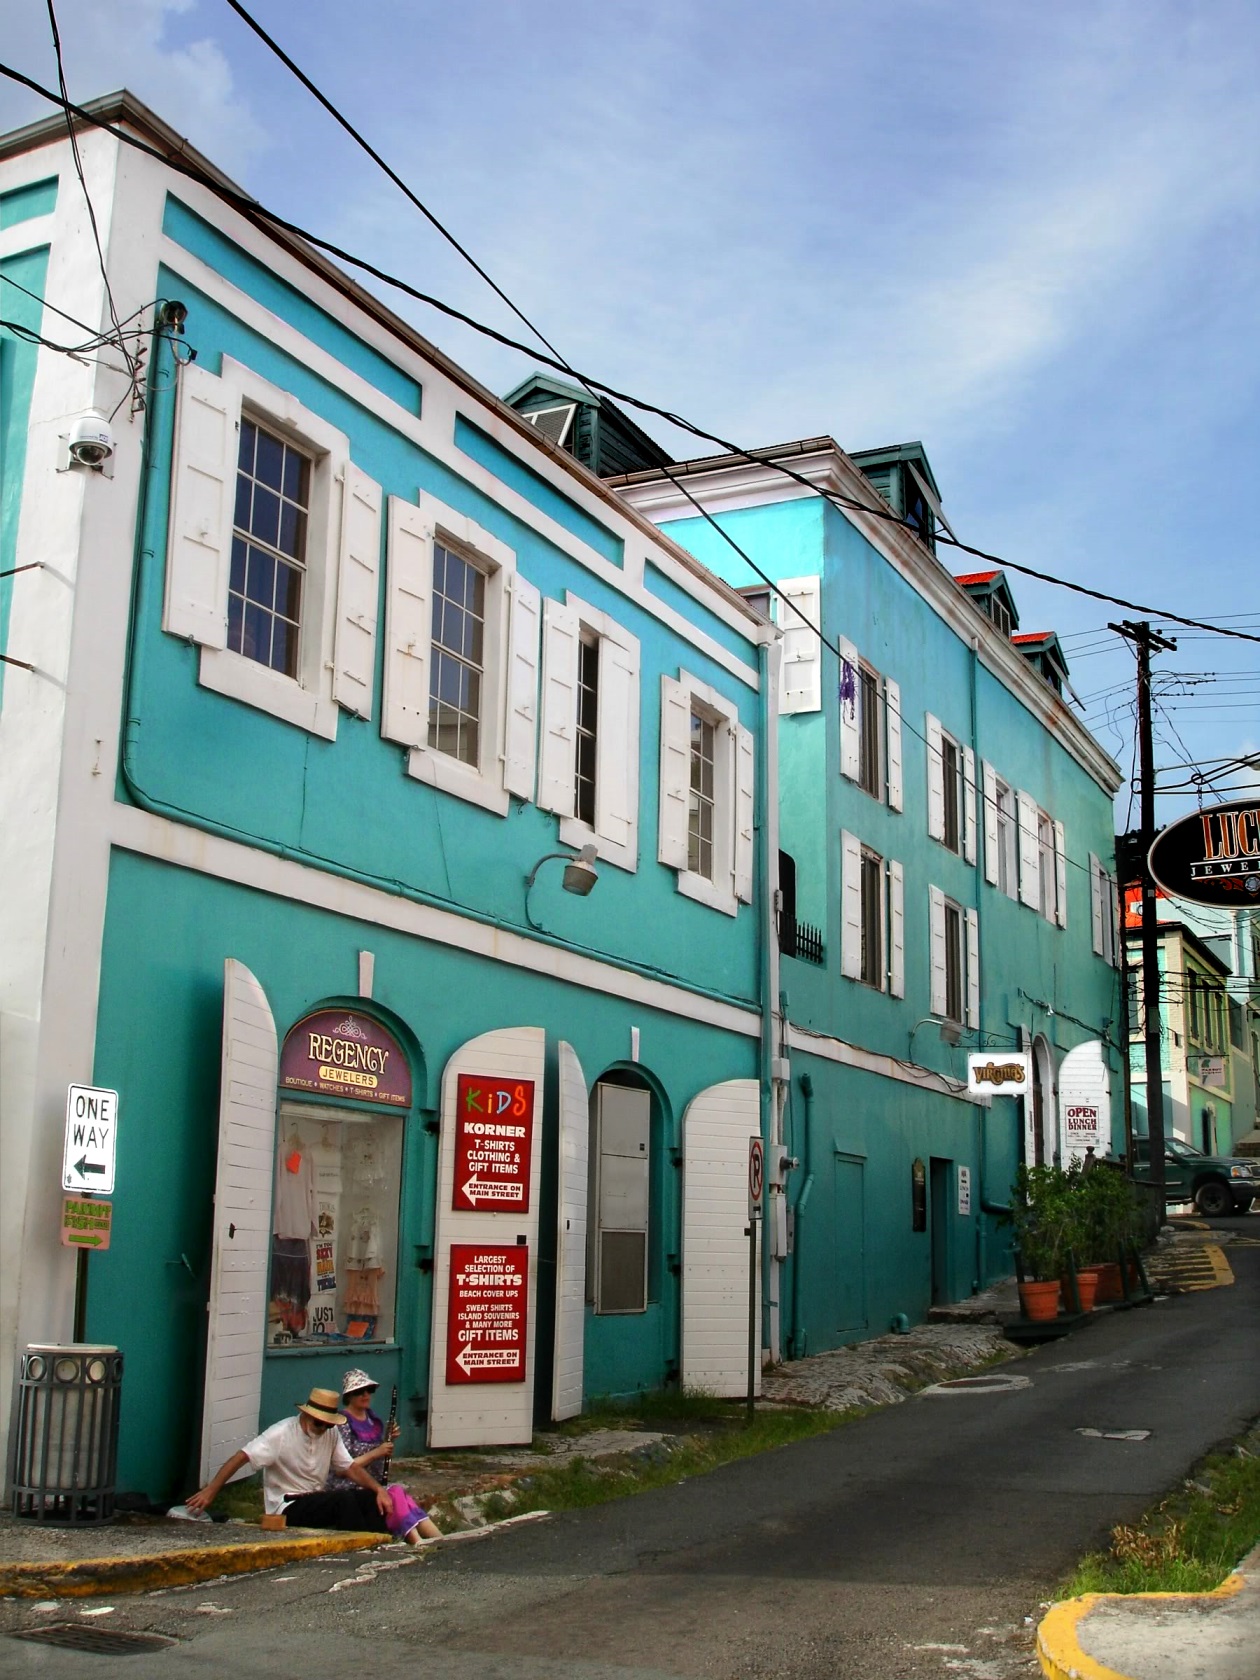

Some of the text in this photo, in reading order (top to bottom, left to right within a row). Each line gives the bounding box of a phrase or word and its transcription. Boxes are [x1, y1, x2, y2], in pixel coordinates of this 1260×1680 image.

[308, 1033, 389, 1074] REGENCY
[322, 1068, 374, 1086] JEWELERS
[285, 1076, 313, 1087] BOUTIQUE
[319, 1082, 344, 1093] WATCHES
[379, 1092, 390, 1101] GIFT
[391, 1094, 405, 1103] ITEMS
[75, 1095, 110, 1122] ONE
[1067, 1107, 1097, 1118] OPEN
[73, 1123, 110, 1149] WAY
[463, 1122, 526, 1138] KORNER
[474, 1139, 515, 1152] T-SHIRTS
[467, 1150, 521, 1163] CLOTHING &
[468, 1162, 518, 1174] GIFT ITEMS
[468, 1183, 521, 1192] ENTRANCE ON
[491, 1190, 520, 1198] STREET
[474, 1255, 507, 1264] LARGEST
[464, 1264, 515, 1273] SELECTION OF
[459, 1290, 519, 1298] BEACH COVER UPS
[465, 1304, 513, 1312] SWEAT SHIRTS
[483, 1312, 520, 1320] SOUVENIRS
[457, 1329, 519, 1342] GIFT ITEMS
